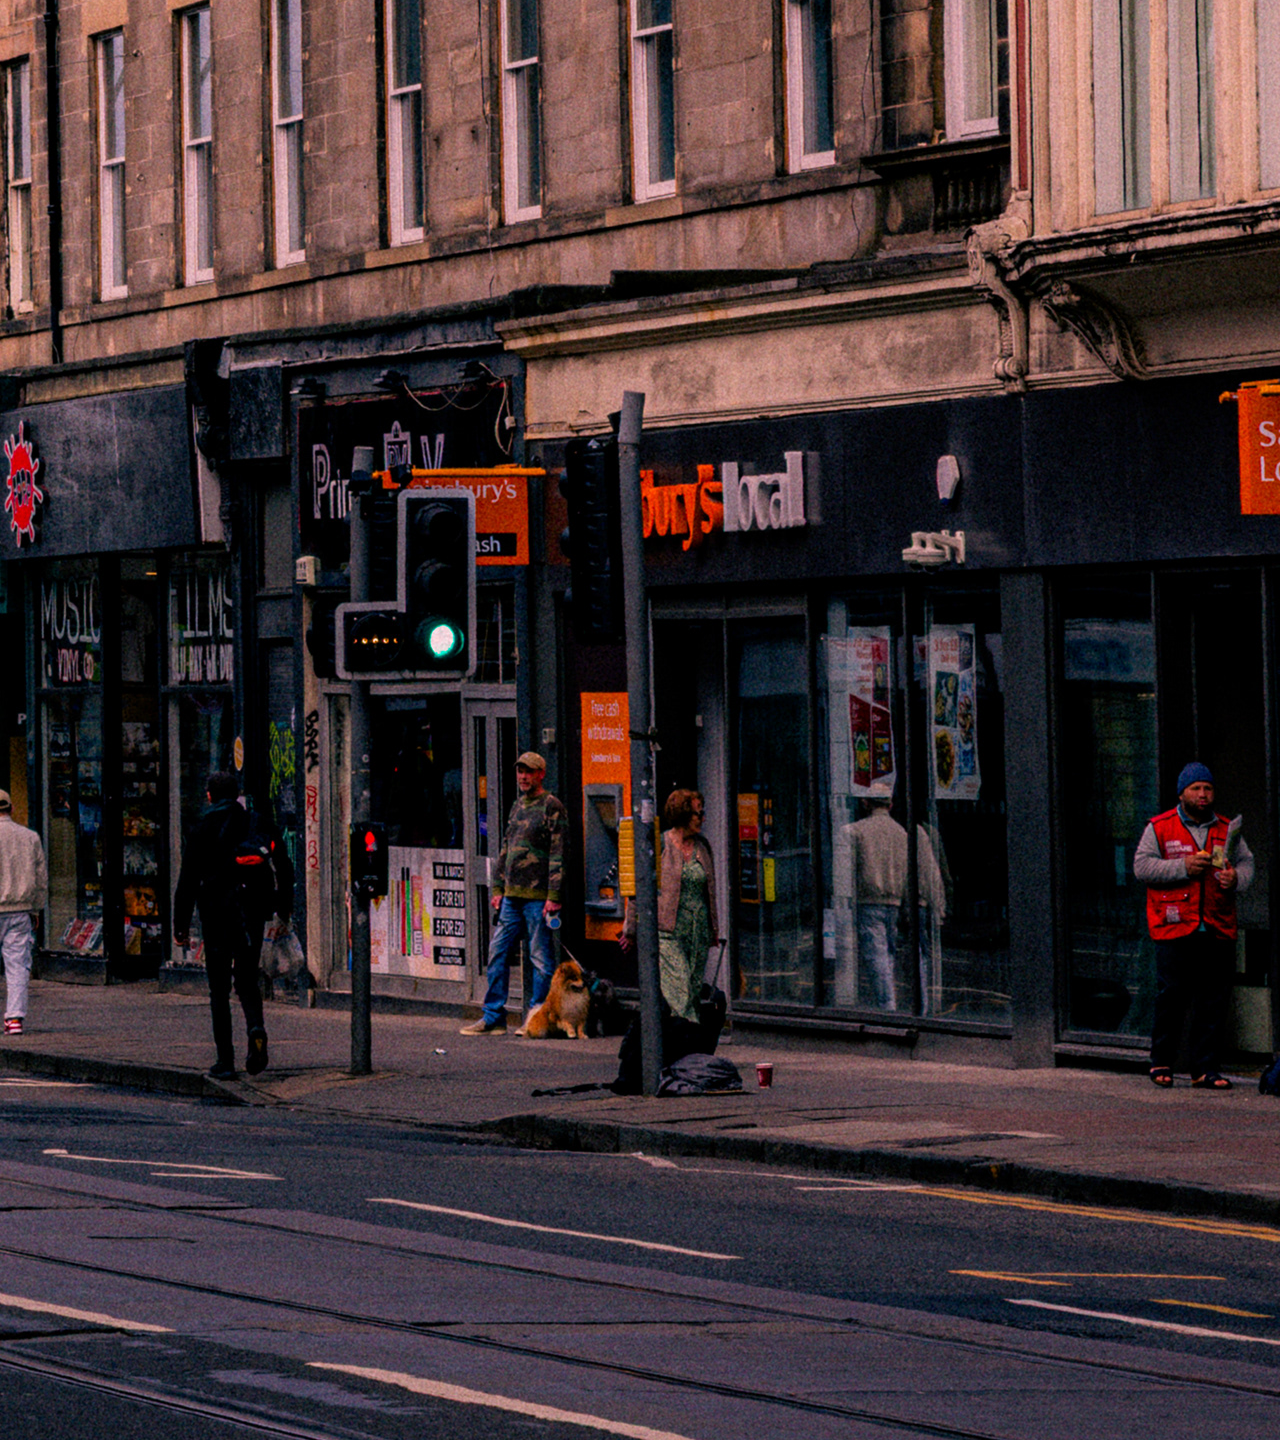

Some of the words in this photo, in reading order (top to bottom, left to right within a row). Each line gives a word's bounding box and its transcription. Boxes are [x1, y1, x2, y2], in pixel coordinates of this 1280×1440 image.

[722, 451, 807, 533] local
[475, 536, 501, 553] ash
[41, 576, 101, 645] MUSIC
[591, 699, 604, 716] Free
[605, 699, 620, 717] cash
[436, 891, 440, 906] 2
[441, 892, 453, 906] FOR
[441, 920, 453, 935] FOR
